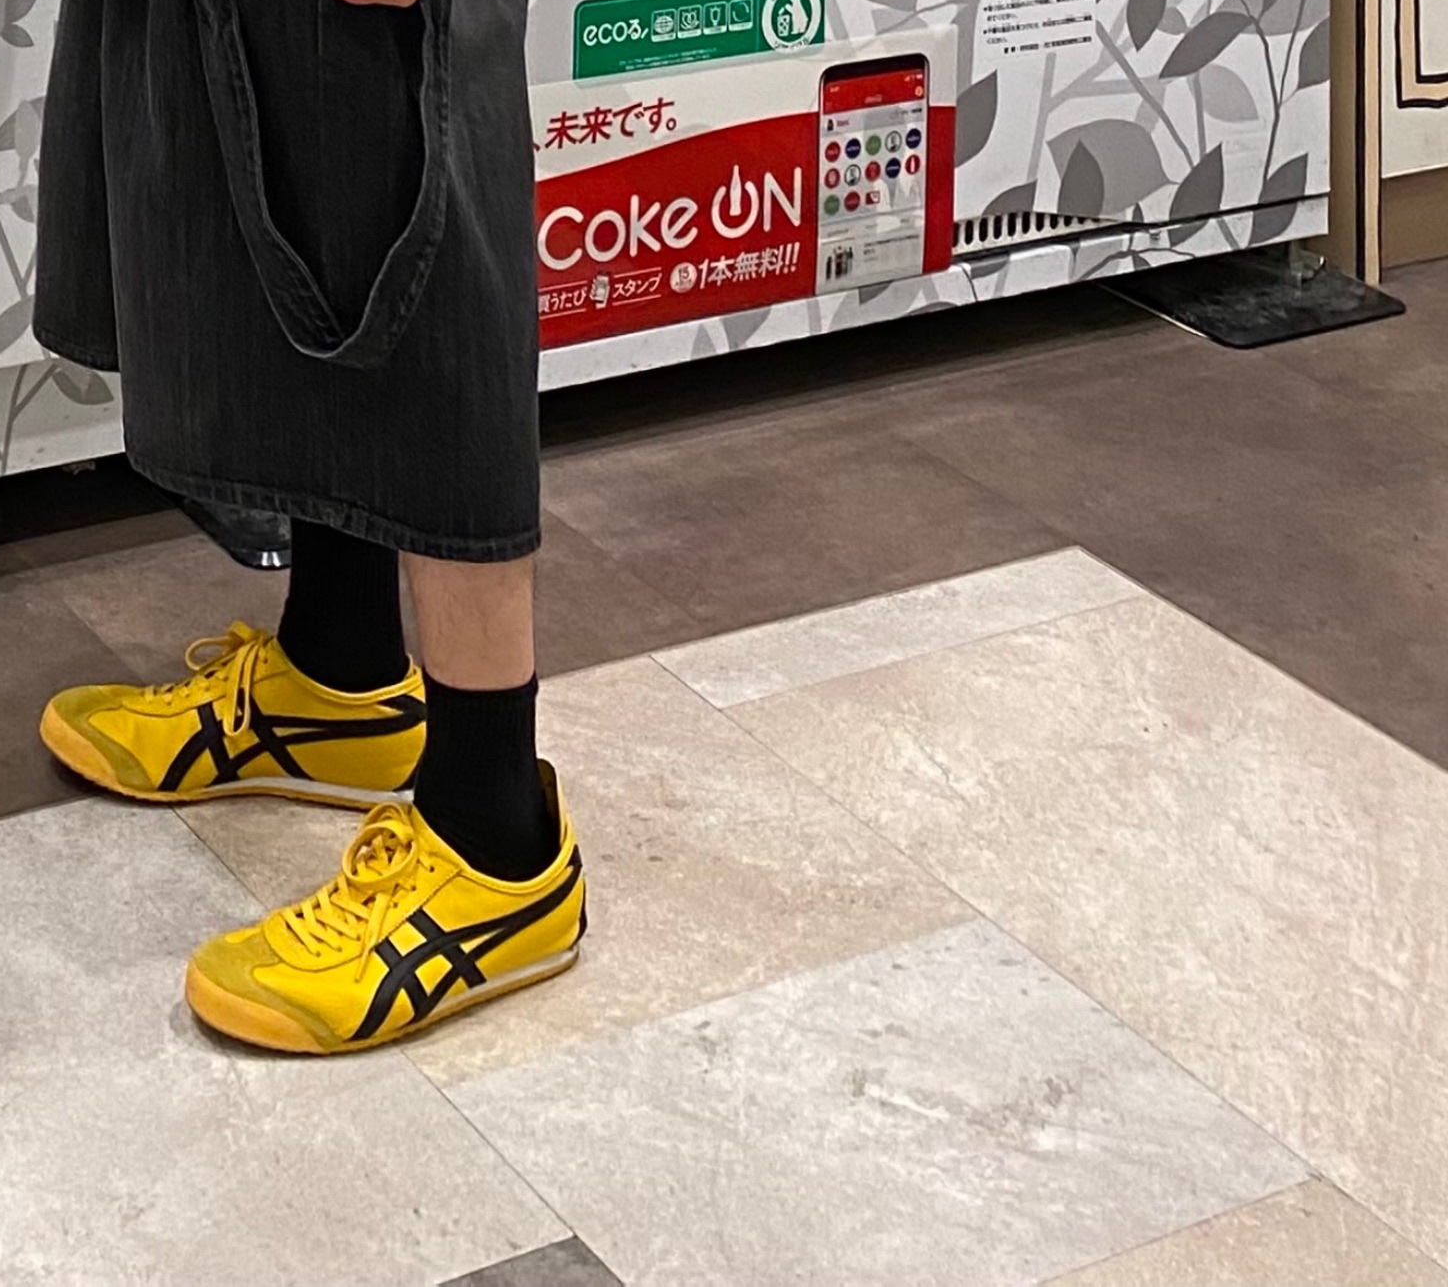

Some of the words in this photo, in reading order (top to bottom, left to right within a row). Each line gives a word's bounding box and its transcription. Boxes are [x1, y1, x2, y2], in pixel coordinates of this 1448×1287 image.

[537, 194, 698, 271] Coke
[711, 164, 802, 239] ON
[613, 273, 662, 298] スタンプ
